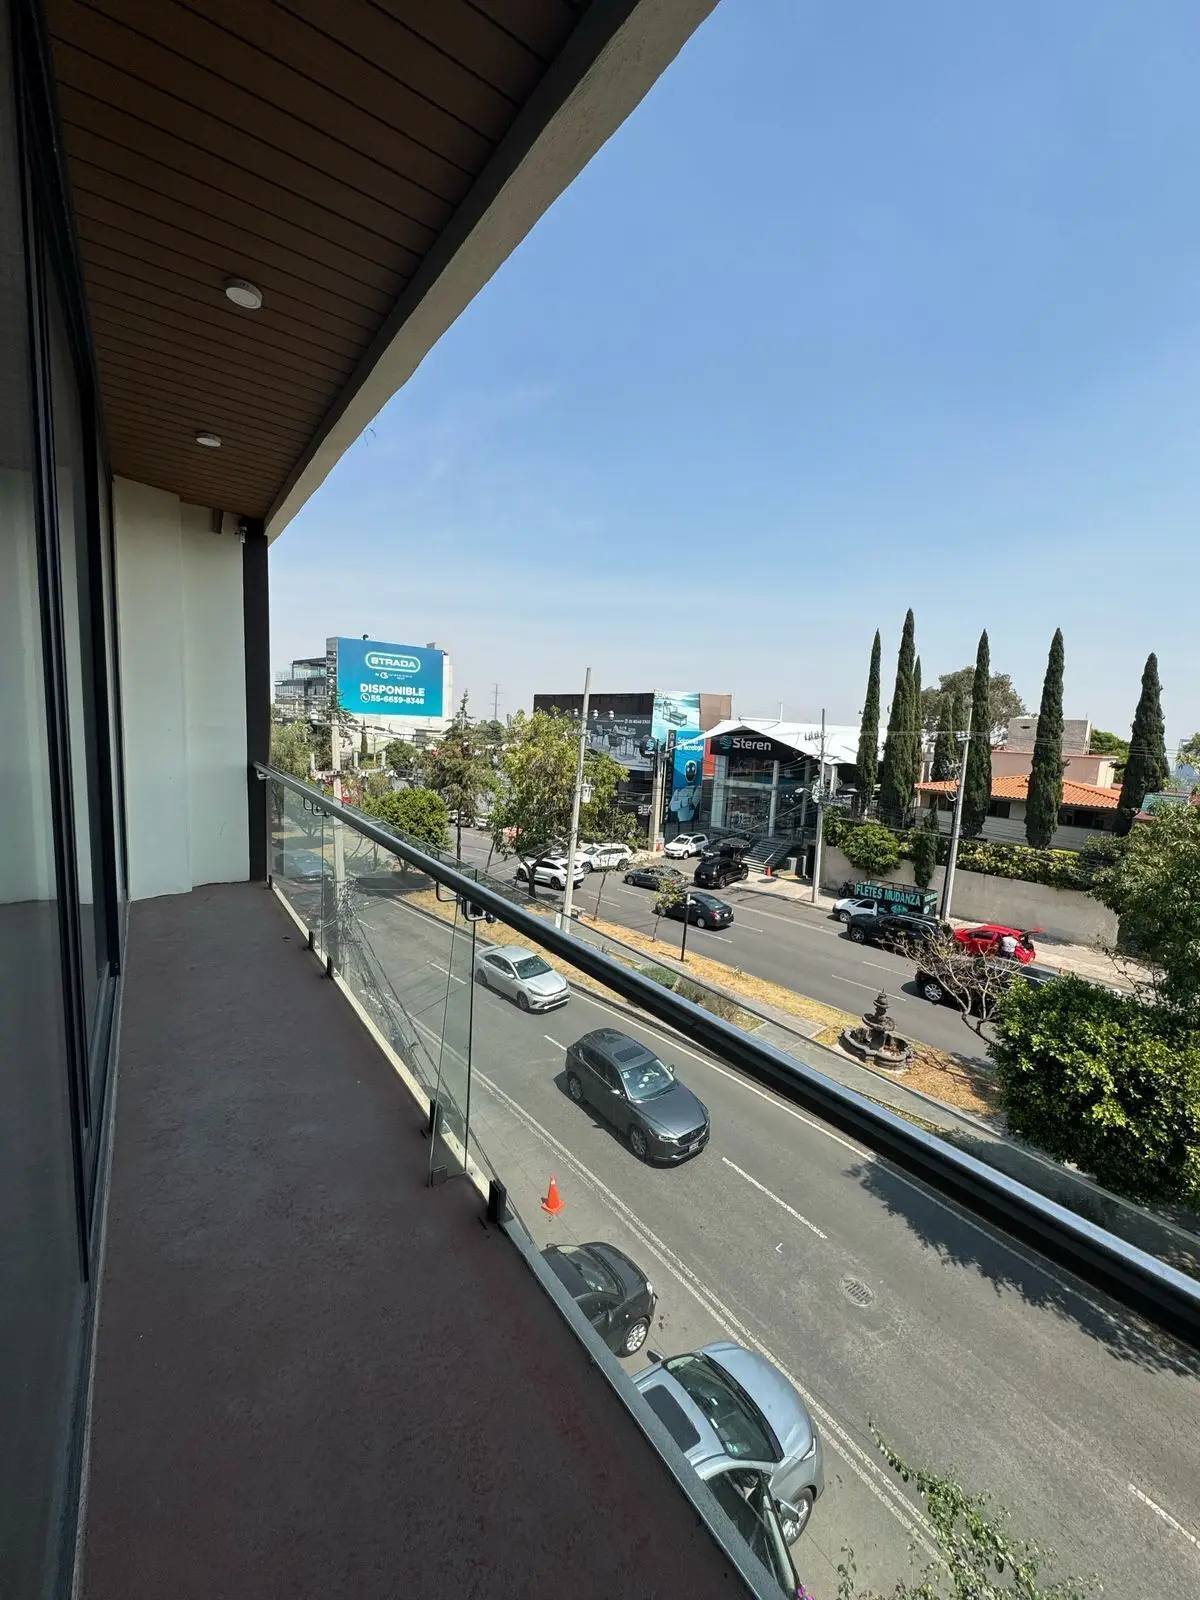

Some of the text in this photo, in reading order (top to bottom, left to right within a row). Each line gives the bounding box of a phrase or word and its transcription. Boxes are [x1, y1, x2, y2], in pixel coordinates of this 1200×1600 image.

[371, 657, 416, 668] STRADA
[360, 683, 425, 696] DISPONIBLE
[732, 738, 772, 751] Steren
[855, 884, 883, 899] FLETES
[884, 888, 920, 906] MUDANZA
